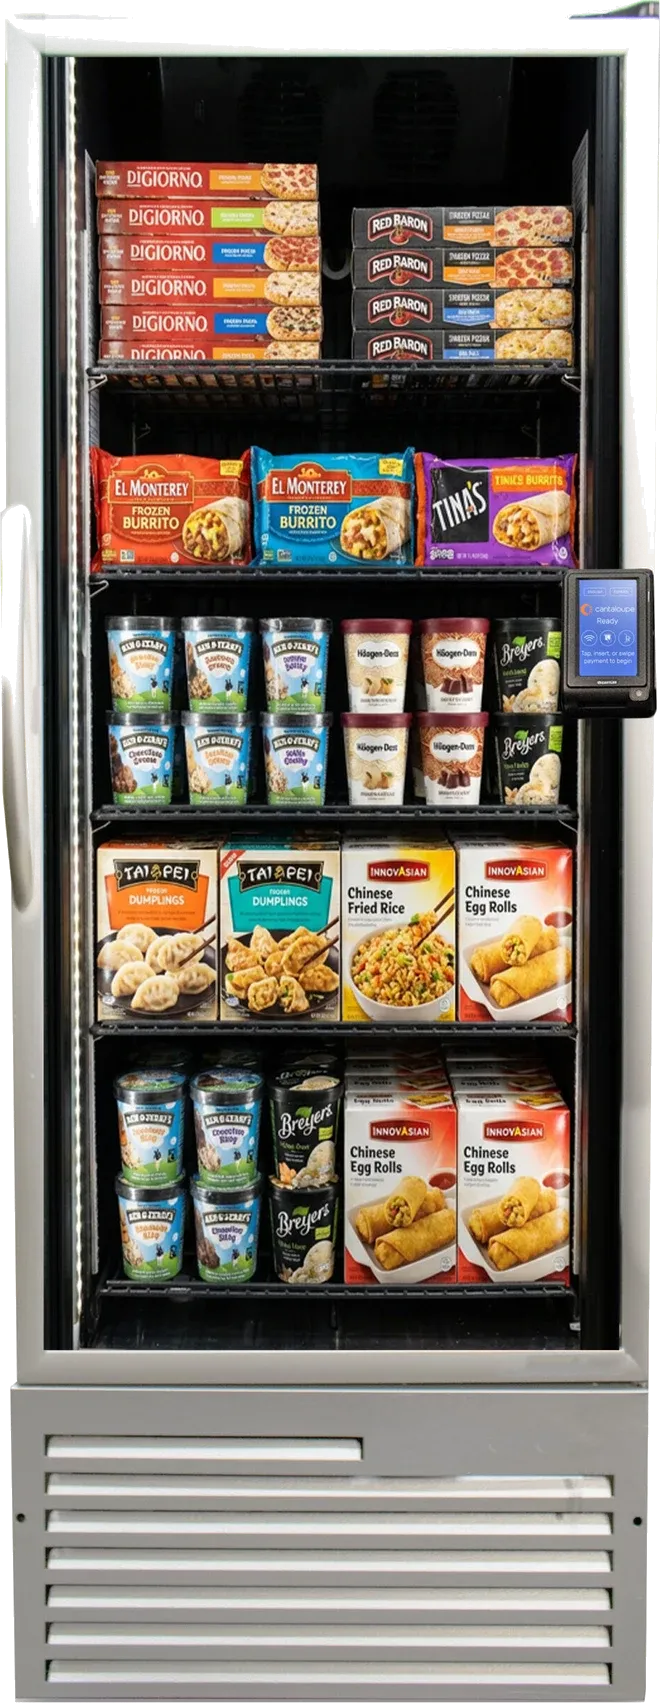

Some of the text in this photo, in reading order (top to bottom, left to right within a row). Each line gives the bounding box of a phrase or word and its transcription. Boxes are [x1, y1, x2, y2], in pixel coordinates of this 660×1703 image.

[372, 214, 428, 232] RED BARON
[372, 257, 392, 273] RED
[393, 254, 428, 274] BARON
[372, 297, 428, 315] RED BARON
[372, 337, 428, 355] RED BARON
[115, 480, 189, 497] EL MONTEREY
[272, 477, 347, 495] EL MONTEREY
[132, 506, 171, 516] FROZEN
[289, 505, 328, 515] FROZEN
[432, 480, 487, 531] TINA'S
[122, 517, 180, 530] BURRITO
[280, 516, 337, 529] BURRITO
[595, 605, 635, 614] cantaloupe
[597, 617, 619, 625] Ready
[500, 636, 543, 667] Breyers
[502, 731, 545, 760] Breyers
[124, 865, 189, 881] TAI PEI
[246, 865, 312, 881] TAI PEI
[347, 886, 393, 899] Chinese
[465, 885, 511, 898] Chinese
[129, 895, 185, 905] DUMPLINGS
[252, 896, 308, 907] DUMPLINGS
[348, 901, 405, 914] Fried Rice
[465, 900, 517, 916] Egg Rolls
[278, 1103, 333, 1139] Breyers
[350, 1146, 396, 1159] Chinese
[463, 1146, 509, 1159] Chinese
[350, 1161, 402, 1176] Egg Rolls
[464, 1161, 516, 1177] Egg Rolls
[276, 1203, 330, 1238] Breyers
